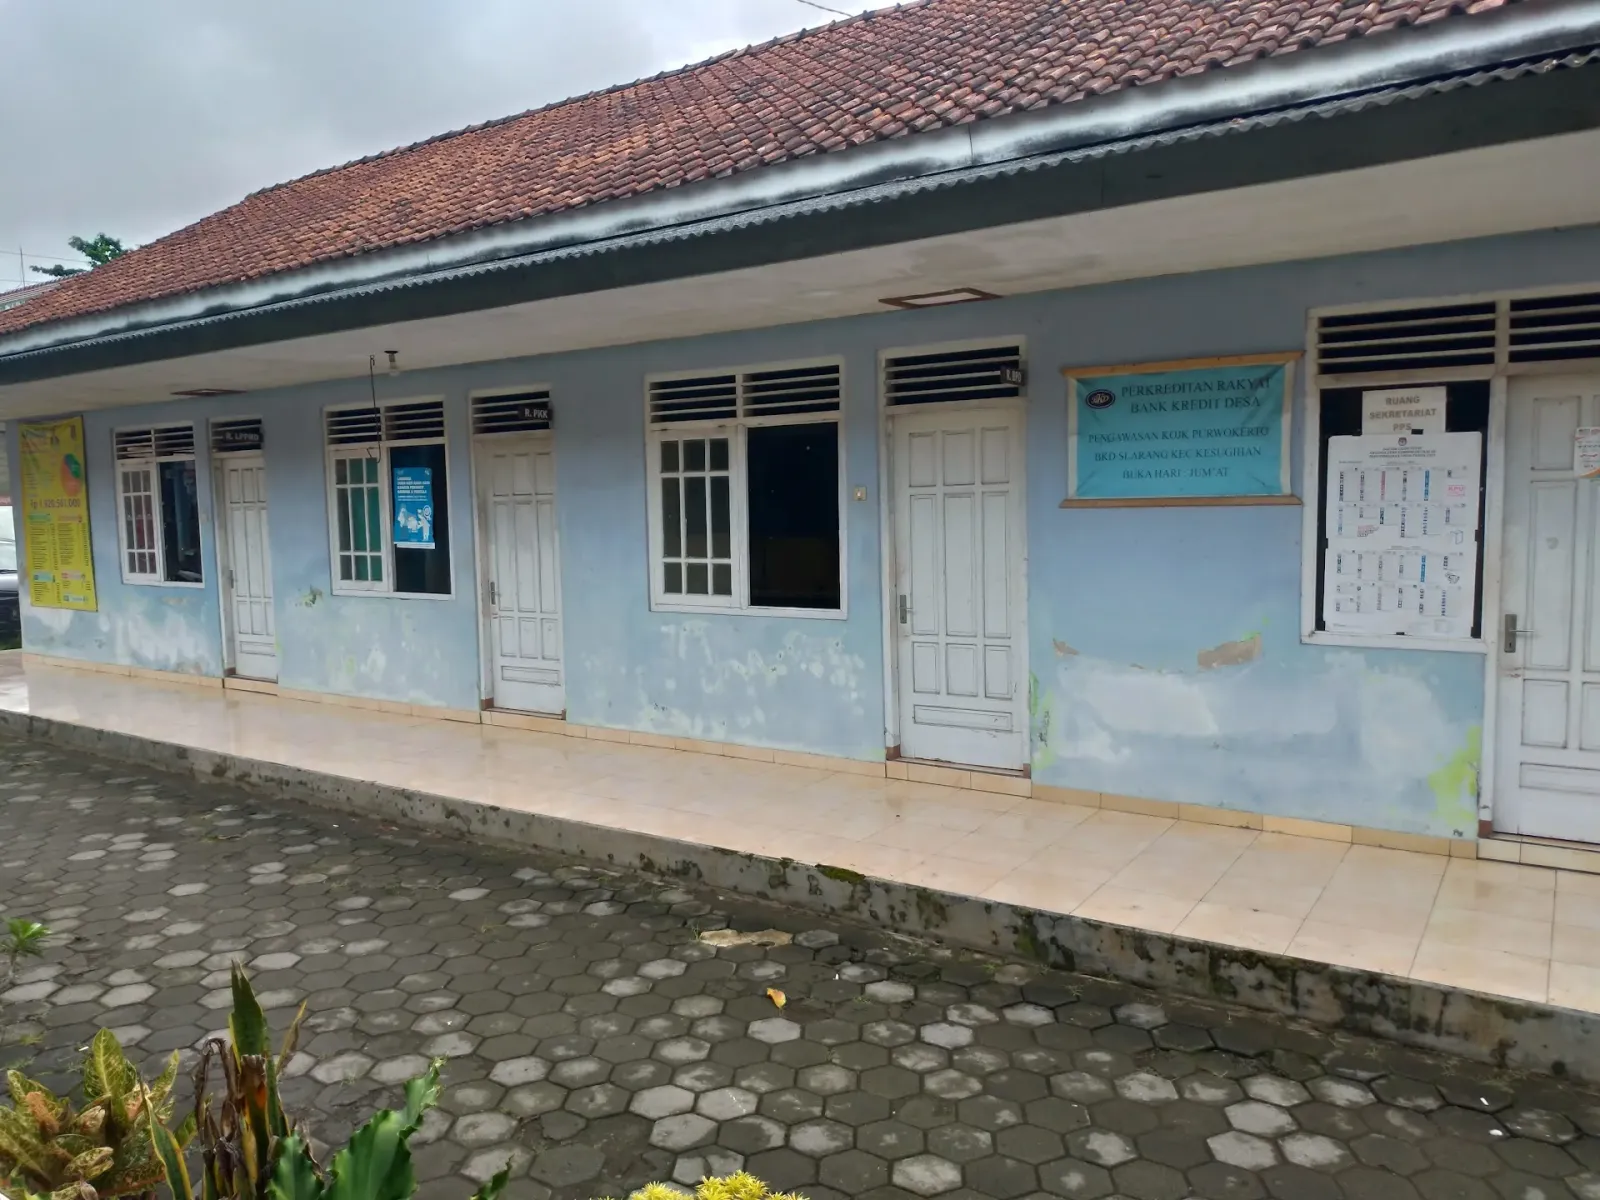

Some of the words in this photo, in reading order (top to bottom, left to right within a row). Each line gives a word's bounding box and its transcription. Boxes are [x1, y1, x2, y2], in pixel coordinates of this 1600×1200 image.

[1121, 381, 1213, 397] PERKREDITAN
[1217, 378, 1271, 391] RAKYAT
[1131, 401, 1167, 414] BANK
[1172, 399, 1222, 412] KREDIT
[1224, 397, 1261, 409] DESA
[1385, 396, 1420, 405] RUANG
[525, 408, 532, 417] R.
[533, 409, 548, 418] PKK
[1369, 408, 1437, 420] SEKRETARIAT
[1393, 423, 1412, 431] PPS
[1088, 432, 1158, 444] PENGAWASAN
[1192, 427, 1270, 438] PURWOKERTO
[1094, 452, 1115, 462] BKD
[1118, 450, 1168, 461] SLARANG
[1171, 449, 1192, 459] KEC
[1195, 446, 1262, 458] KESUGIHAN
[1122, 470, 1151, 479] BUKA
[1154, 469, 1180, 479] HARI
